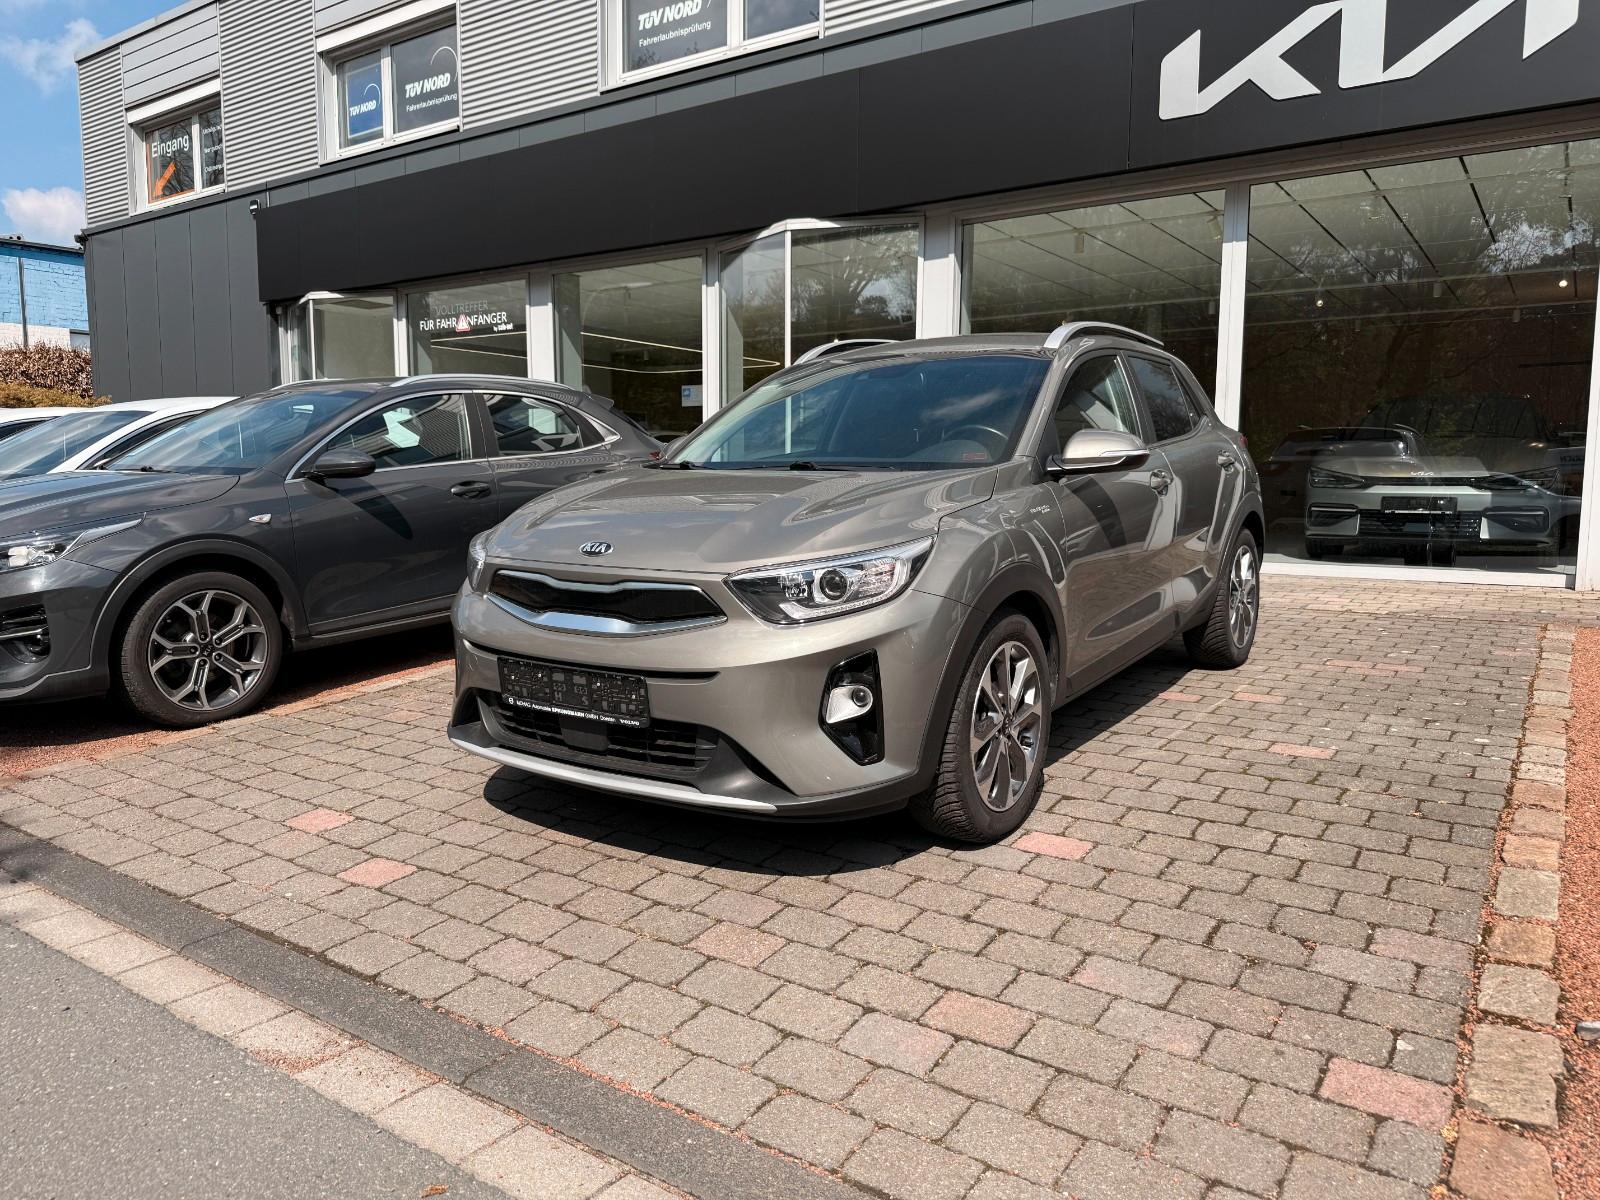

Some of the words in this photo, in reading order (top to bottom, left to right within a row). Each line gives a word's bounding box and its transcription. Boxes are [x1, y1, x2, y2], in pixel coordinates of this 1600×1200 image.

[638, 11, 662, 31] TÜV
[662, 0, 703, 24] NORD
[639, 20, 711, 48] Fahrerlaubnisprüfung
[405, 79, 422, 98] TÜV
[423, 72, 451, 93] NORD
[360, 99, 377, 113] NORD
[151, 134, 189, 158] Eingang
[420, 317, 435, 331] FÜR
[582, 542, 608, 553] KIA
